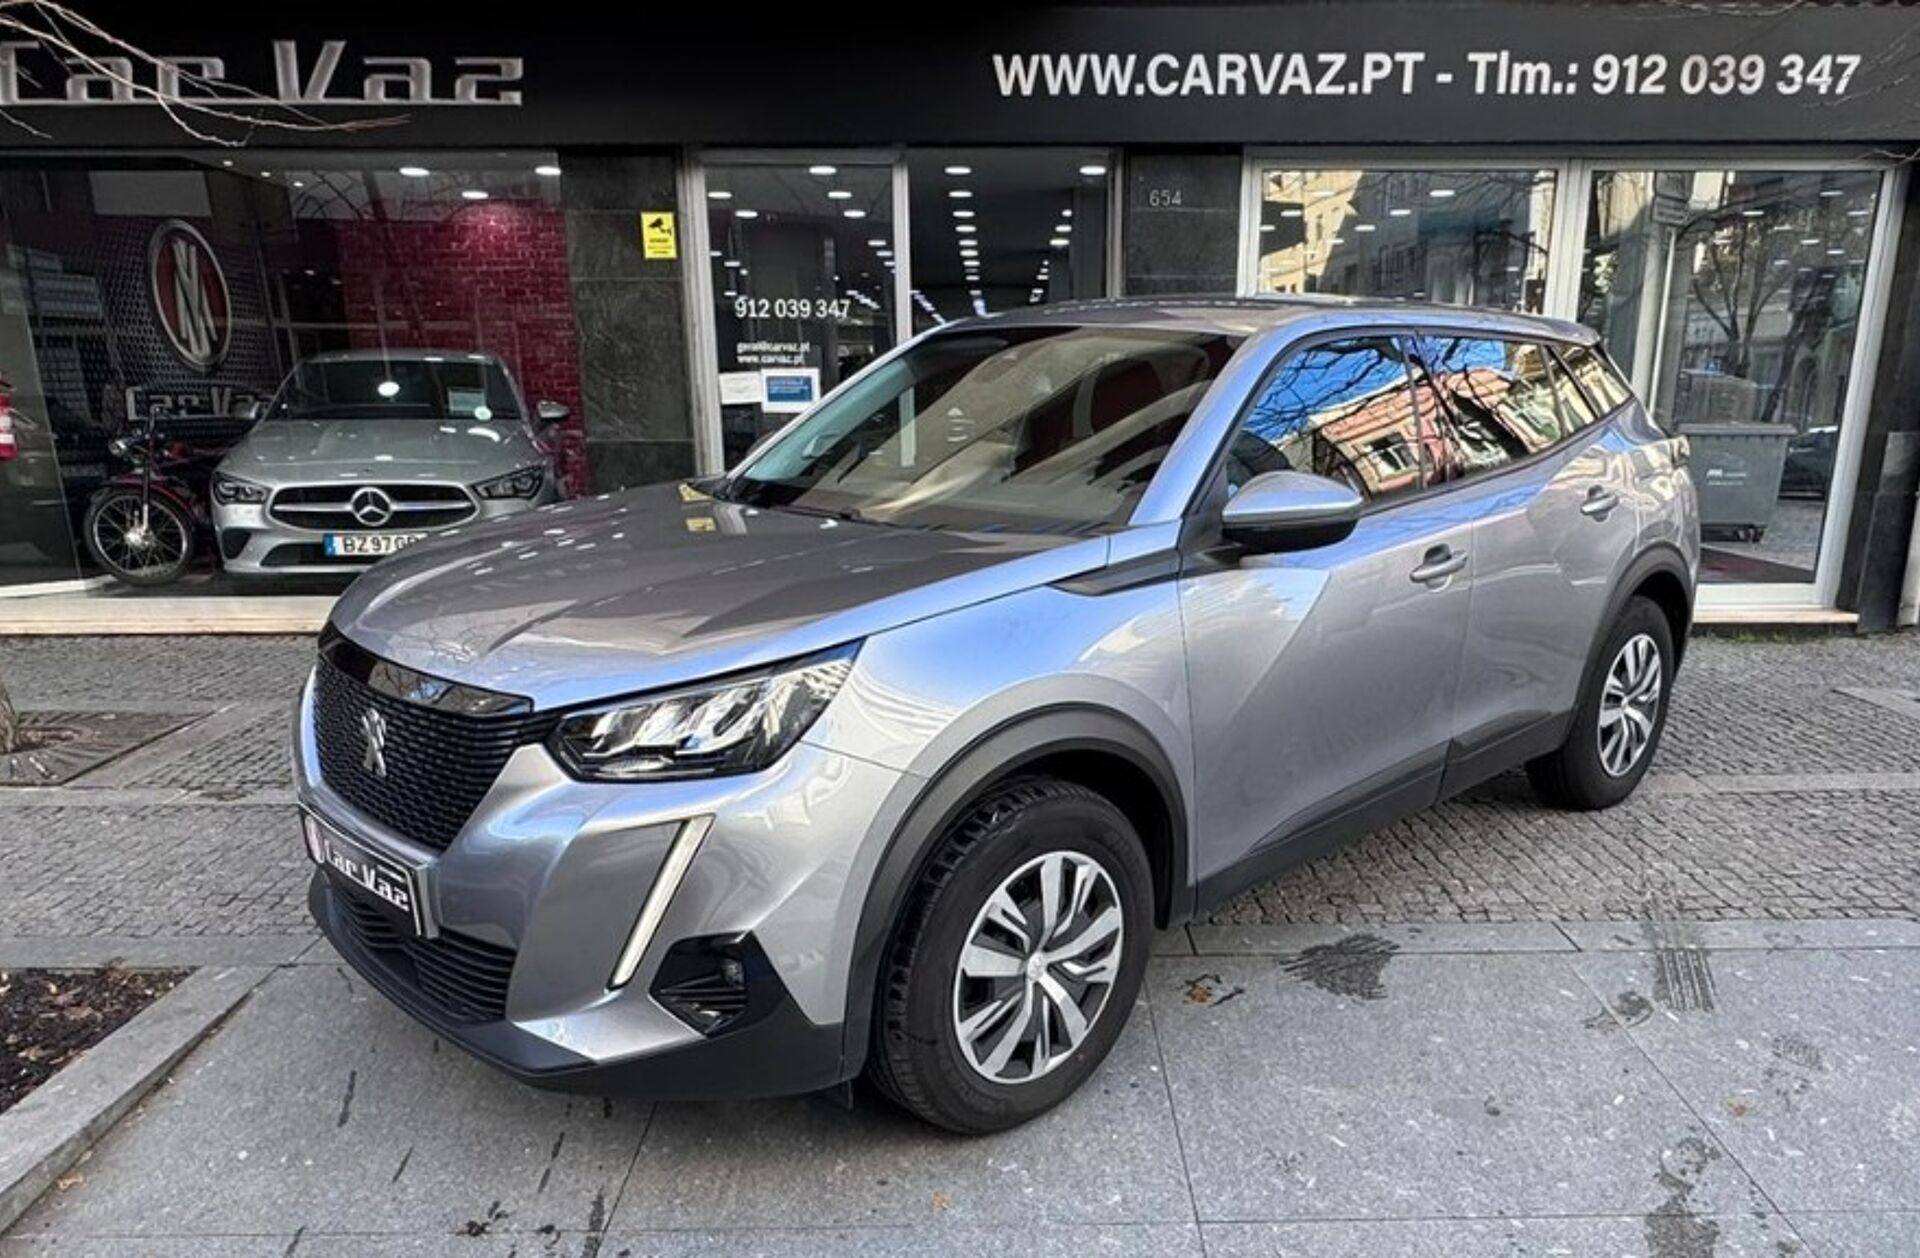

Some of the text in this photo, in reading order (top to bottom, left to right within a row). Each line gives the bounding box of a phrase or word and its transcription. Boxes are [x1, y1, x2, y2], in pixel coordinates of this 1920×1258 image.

[992, 51, 1426, 97] WWW.CARVAZ.PT
[1466, 49, 1579, 96] Tlm.:
[1591, 53, 1668, 96] 912
[1679, 53, 1766, 96] 039
[1775, 53, 1861, 96] 347
[1149, 189, 1182, 207] 654
[734, 297, 852, 319] 912 039 347
